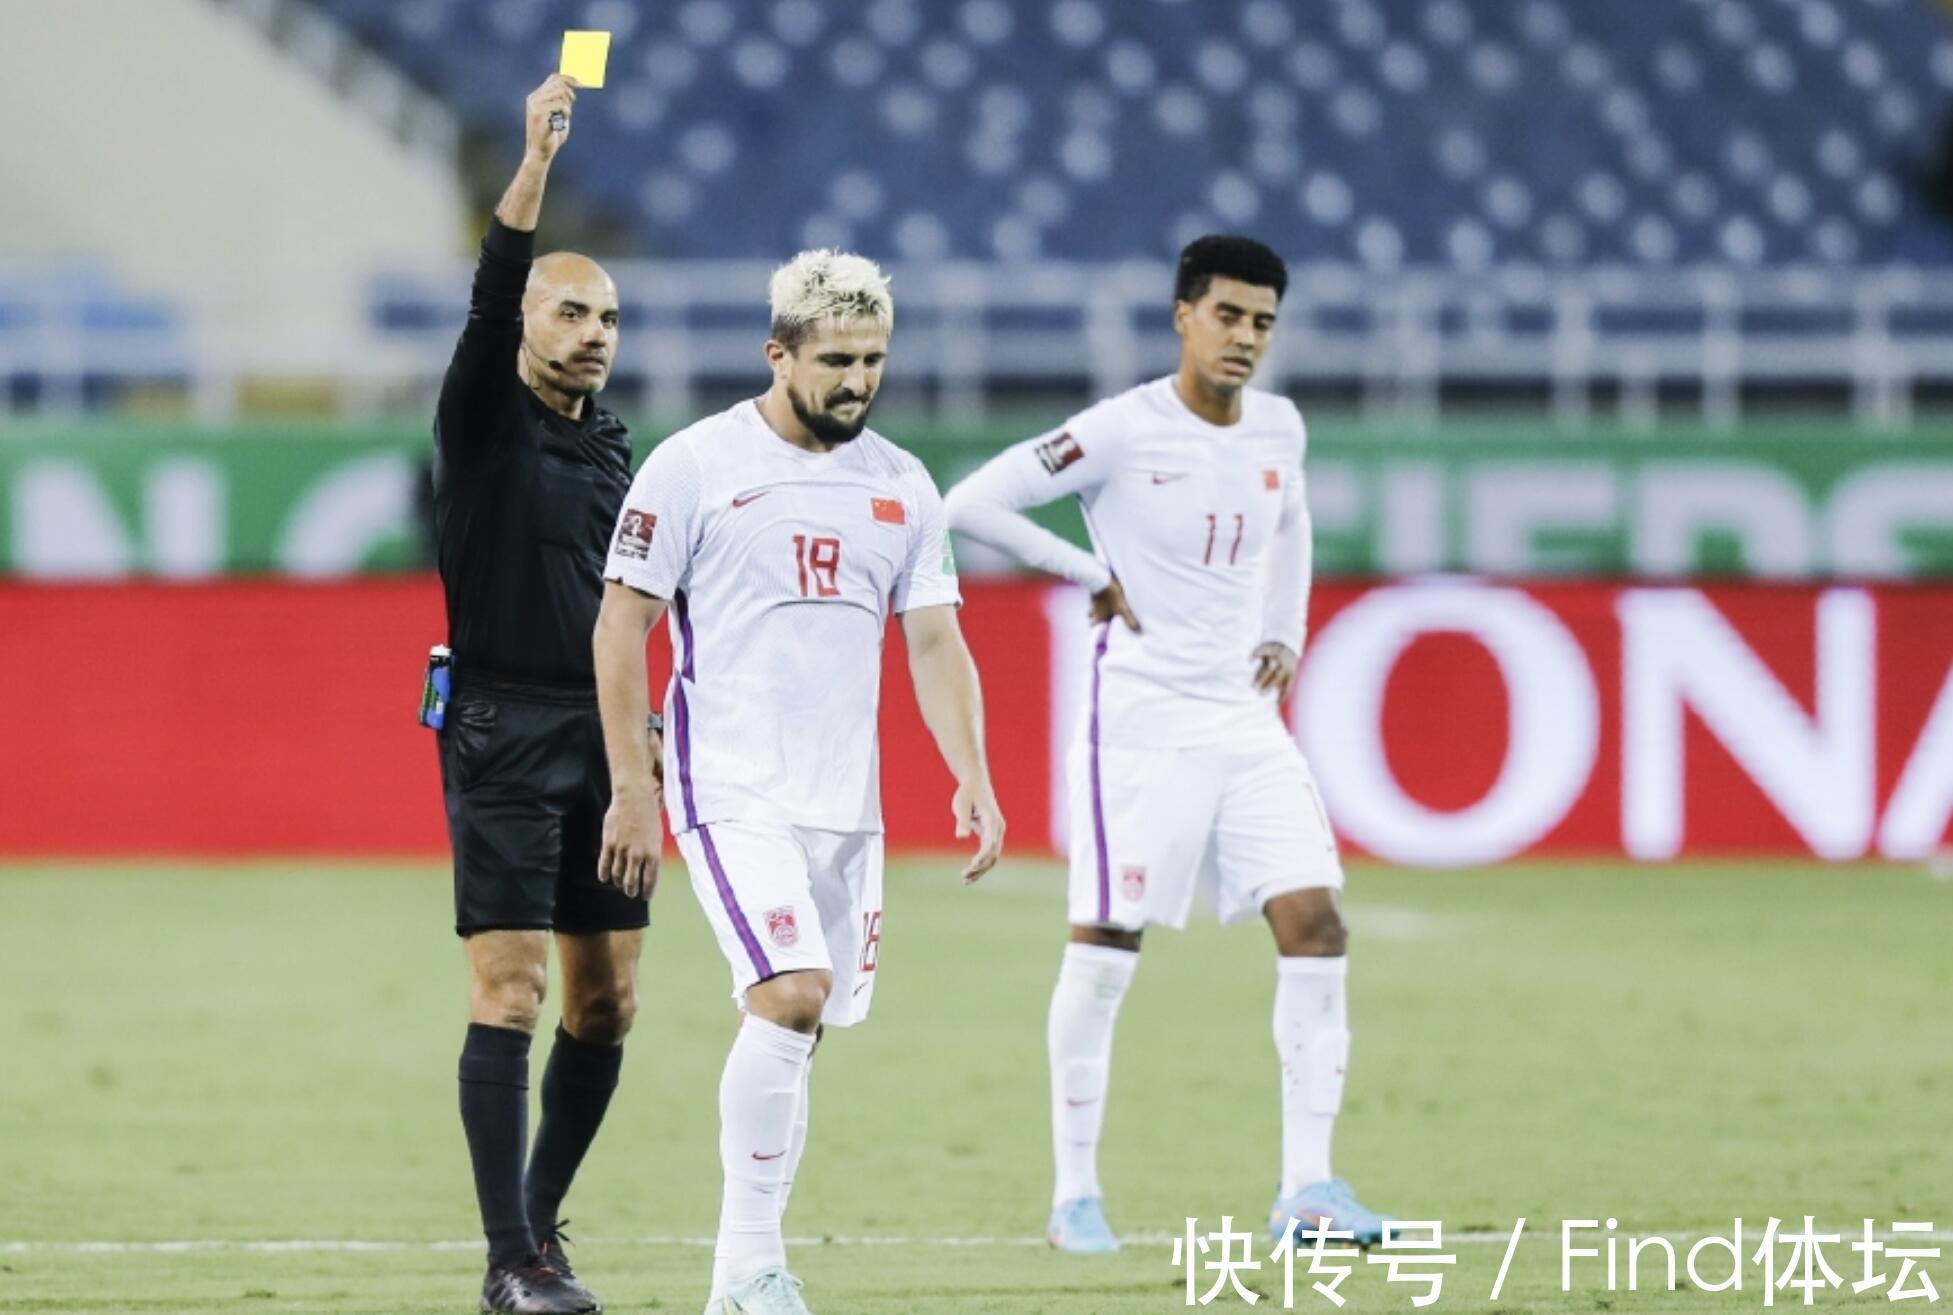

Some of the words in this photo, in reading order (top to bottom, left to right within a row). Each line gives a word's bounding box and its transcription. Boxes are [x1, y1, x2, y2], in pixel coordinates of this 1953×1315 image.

[792, 534, 841, 598] 18
[1203, 513, 1244, 567] 11
[1042, 574, 1953, 868] ON
